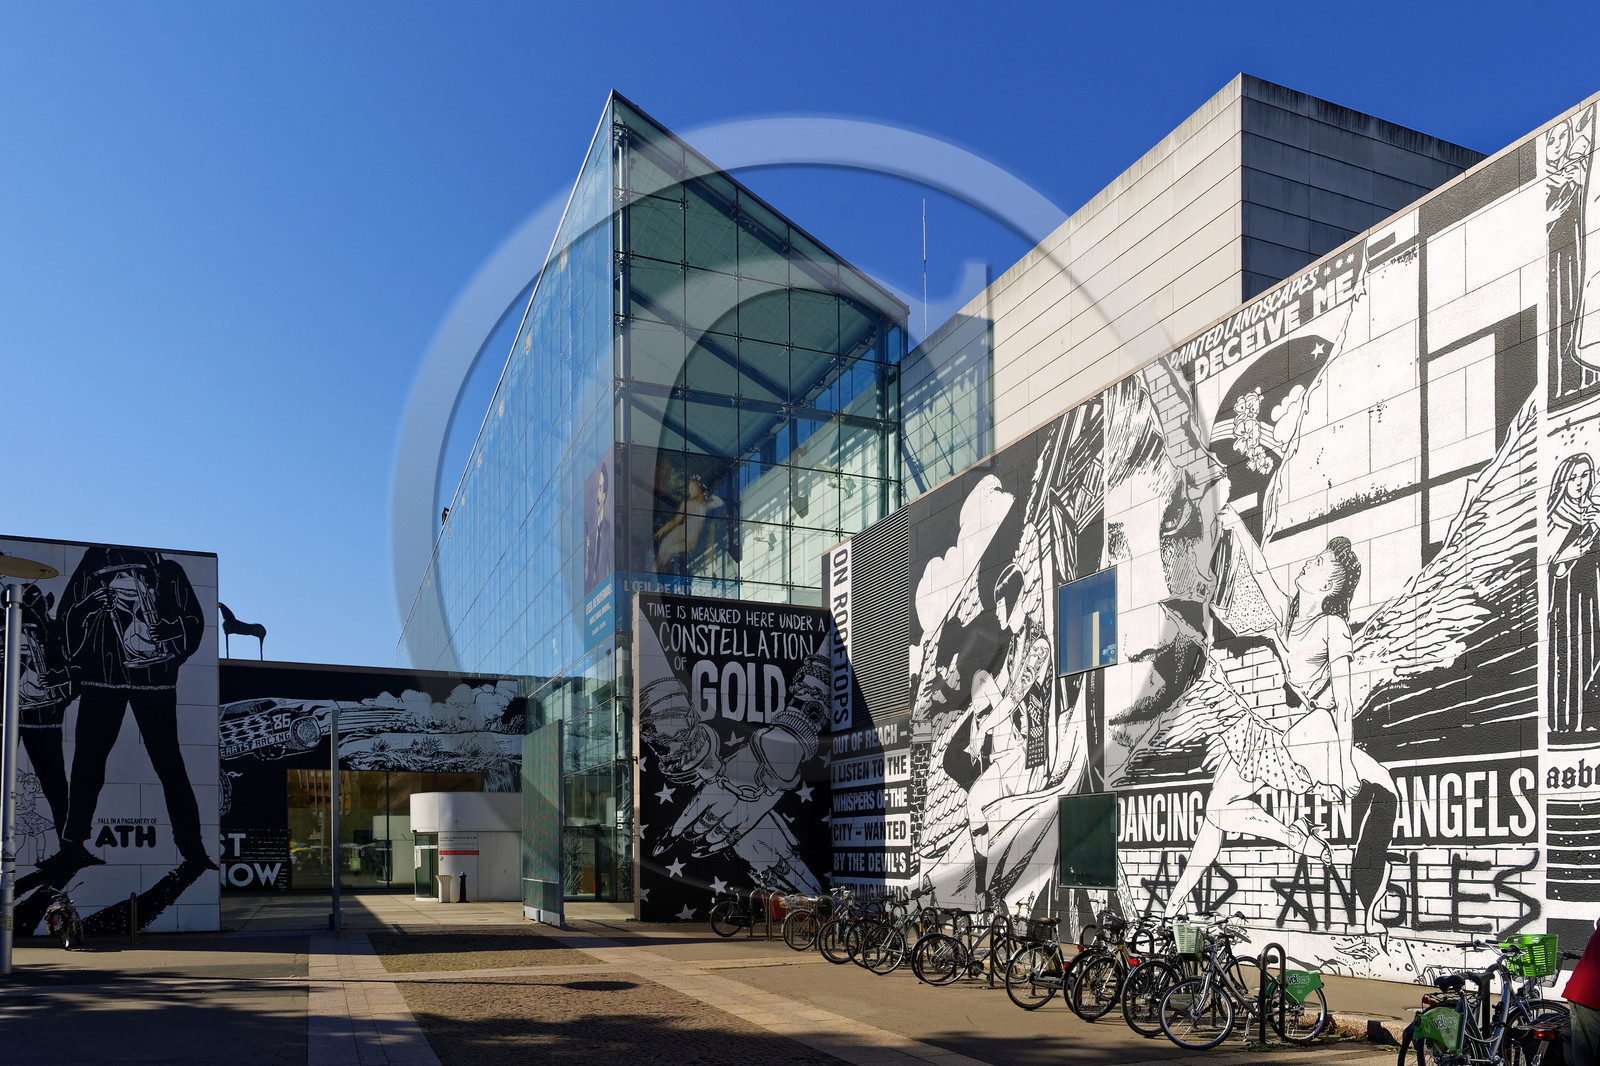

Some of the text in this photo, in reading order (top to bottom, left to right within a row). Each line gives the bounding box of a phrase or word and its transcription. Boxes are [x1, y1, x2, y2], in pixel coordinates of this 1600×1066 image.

[1170, 266, 1319, 370] PAINTED LANDSCAPES
[1194, 269, 1354, 384] DECEIVE ME
[647, 602, 826, 633] TIME IS MEASURED HERE UNDER A
[659, 621, 814, 661] CONSTELLATION
[833, 548, 848, 726] ON ROOFTOPS
[674, 656, 688, 671] OF
[691, 659, 787, 725] GOLD
[271, 713, 291, 731] 86
[254, 731, 291, 749] RACING
[832, 734, 850, 755] OUT
[851, 731, 863, 751] OF
[865, 723, 898, 749] REACH
[832, 754, 907, 784] I LISTEN TO THE
[833, 786, 907, 813] WHISPERS OF THE
[1117, 767, 1536, 843] DANCING TWEEN ANGELS
[95, 825, 156, 848] ATH
[833, 822, 853, 842] CITY
[864, 820, 907, 841] WANTED
[833, 852, 907, 873] BY THE DEVIL'S
[833, 882, 909, 904] RLING WINDS
